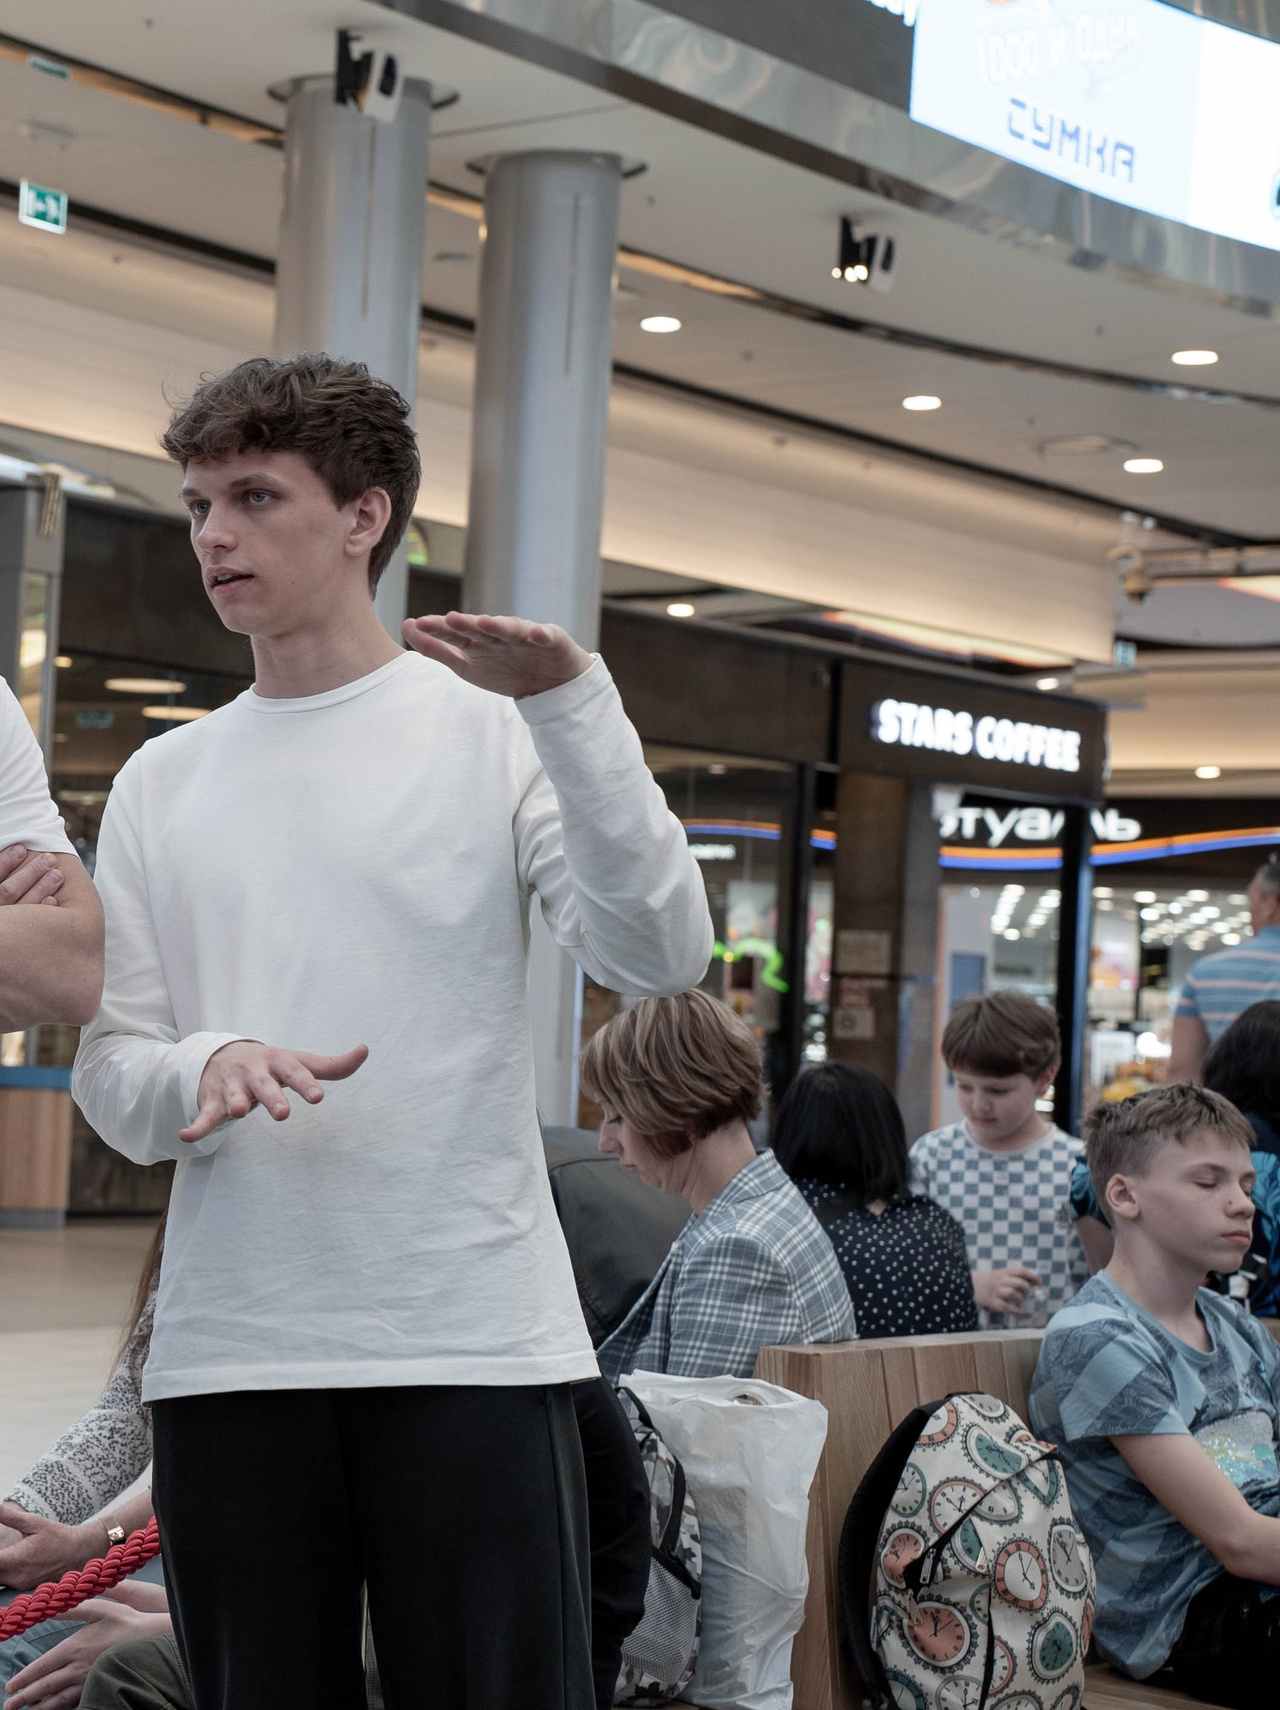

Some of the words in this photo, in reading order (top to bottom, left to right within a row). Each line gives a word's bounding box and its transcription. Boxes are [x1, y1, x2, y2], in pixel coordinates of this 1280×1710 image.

[975, 30, 1041, 84] 1000
[1007, 97, 1137, 184] СУМКА
[878, 699, 973, 755] STARS
[975, 716, 1081, 772] COFFEE
